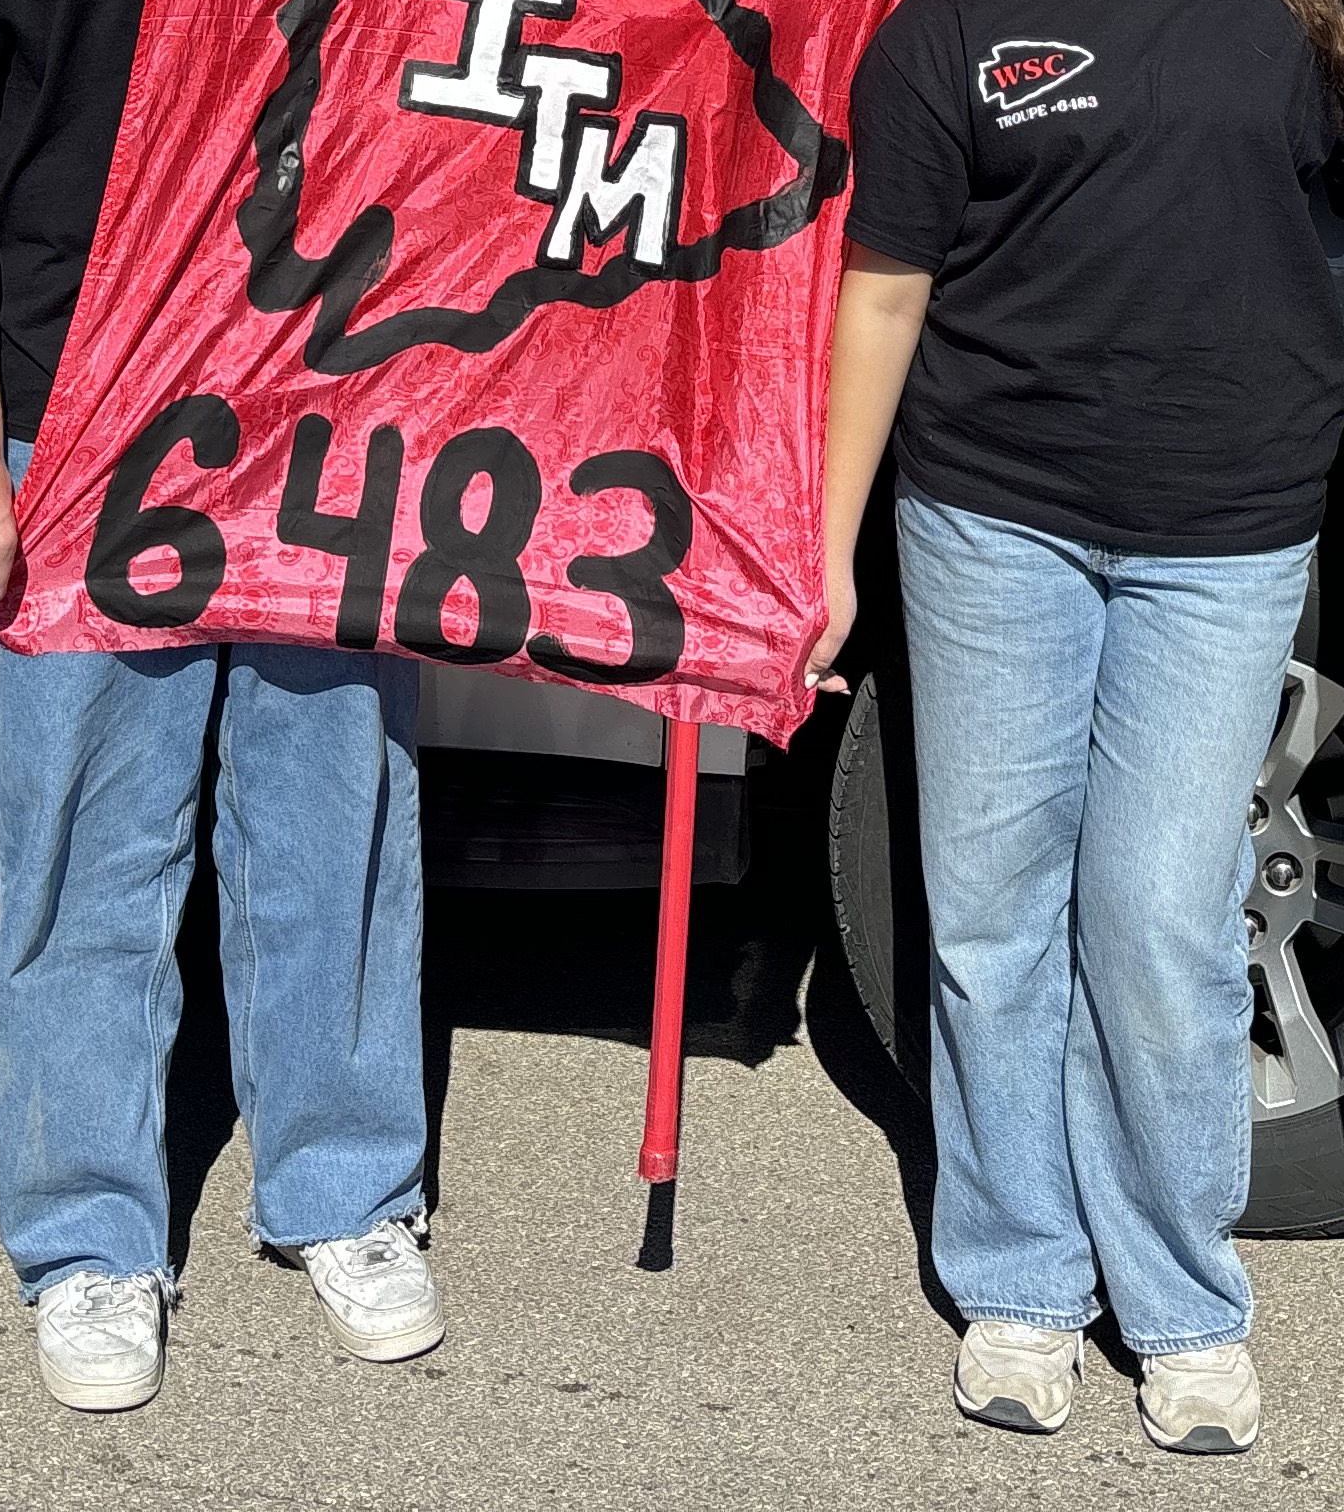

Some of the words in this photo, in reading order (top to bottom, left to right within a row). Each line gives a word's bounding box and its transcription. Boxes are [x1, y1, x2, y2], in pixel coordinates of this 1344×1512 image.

[992, 54, 1066, 88] WSC
[996, 104, 1048, 129] TROUPE
[84, 394, 692, 684] 6483
